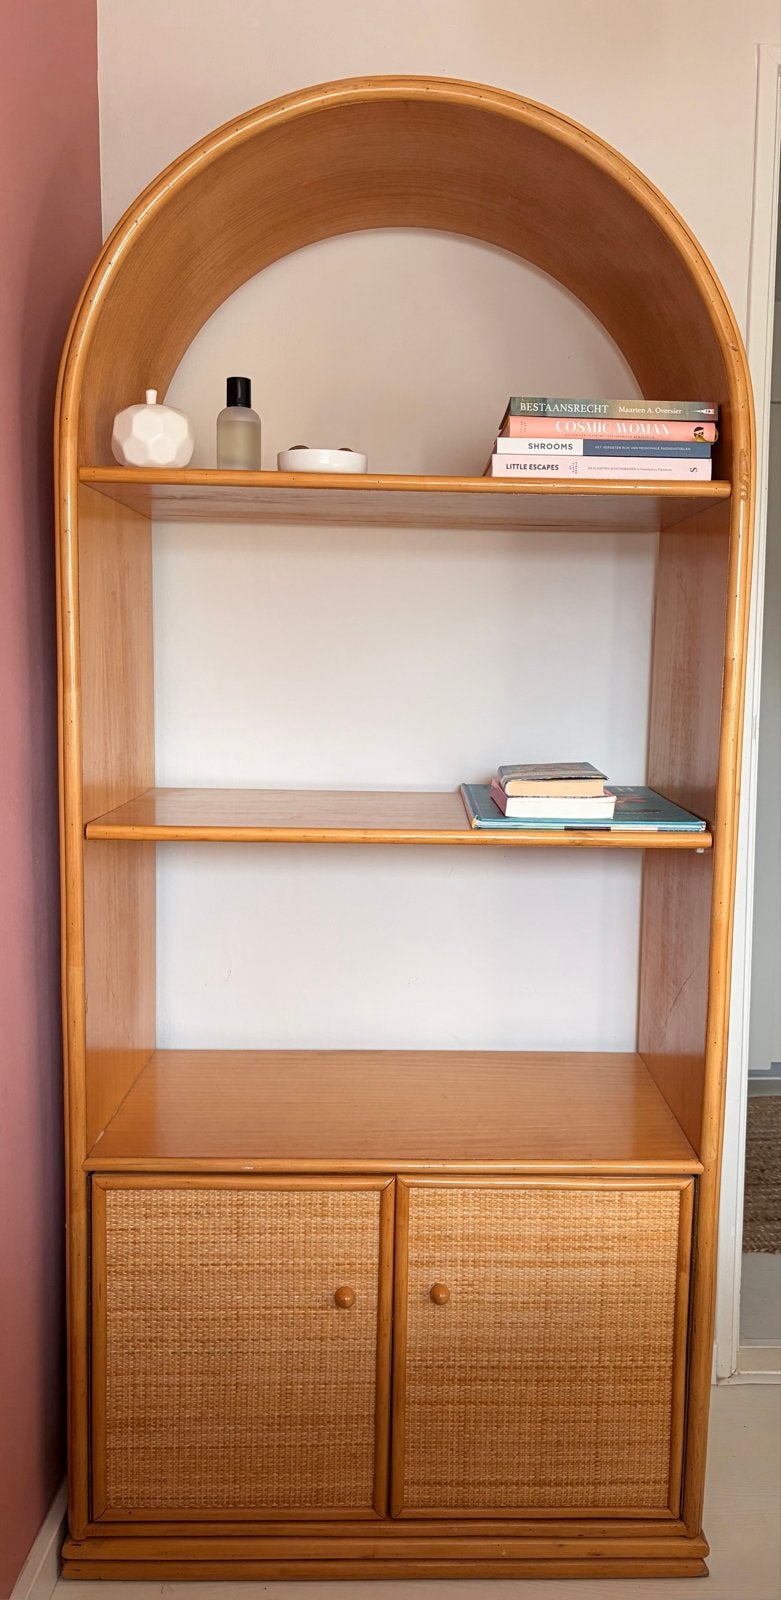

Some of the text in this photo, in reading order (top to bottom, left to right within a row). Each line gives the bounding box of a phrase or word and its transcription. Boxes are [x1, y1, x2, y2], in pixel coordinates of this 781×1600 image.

[520, 402, 609, 414] BESTAANSRECHT
[556, 421, 670, 435] COSMIC WOMAN
